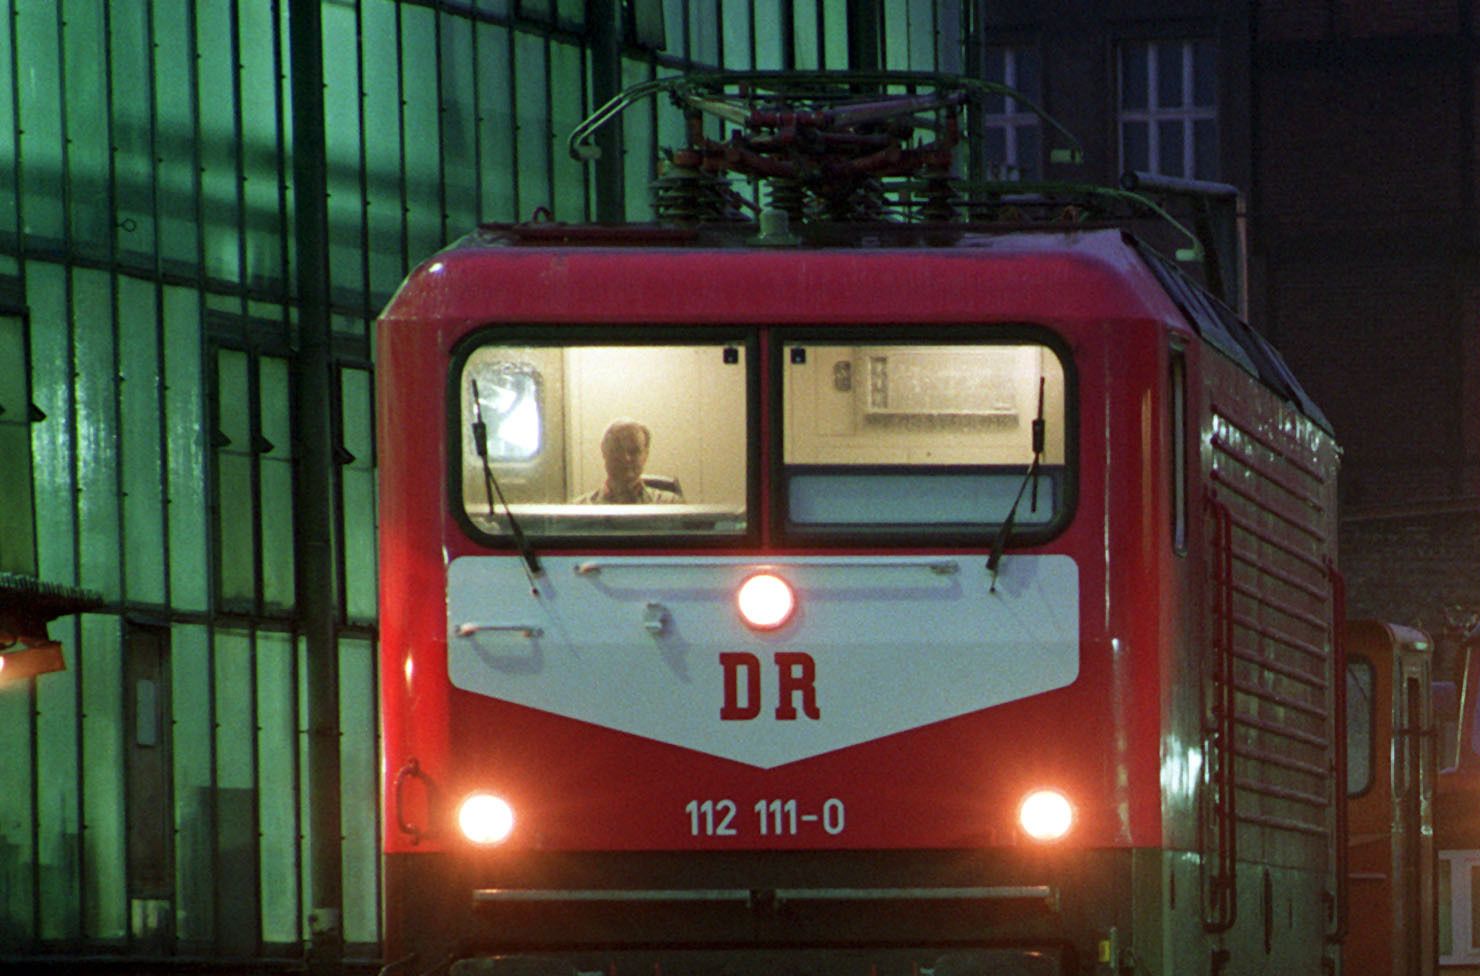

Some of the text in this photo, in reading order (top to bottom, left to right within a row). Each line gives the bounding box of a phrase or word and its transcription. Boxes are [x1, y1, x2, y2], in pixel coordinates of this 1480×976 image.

[719, 652, 821, 721] DR
[685, 798, 845, 836] 112 111-0
